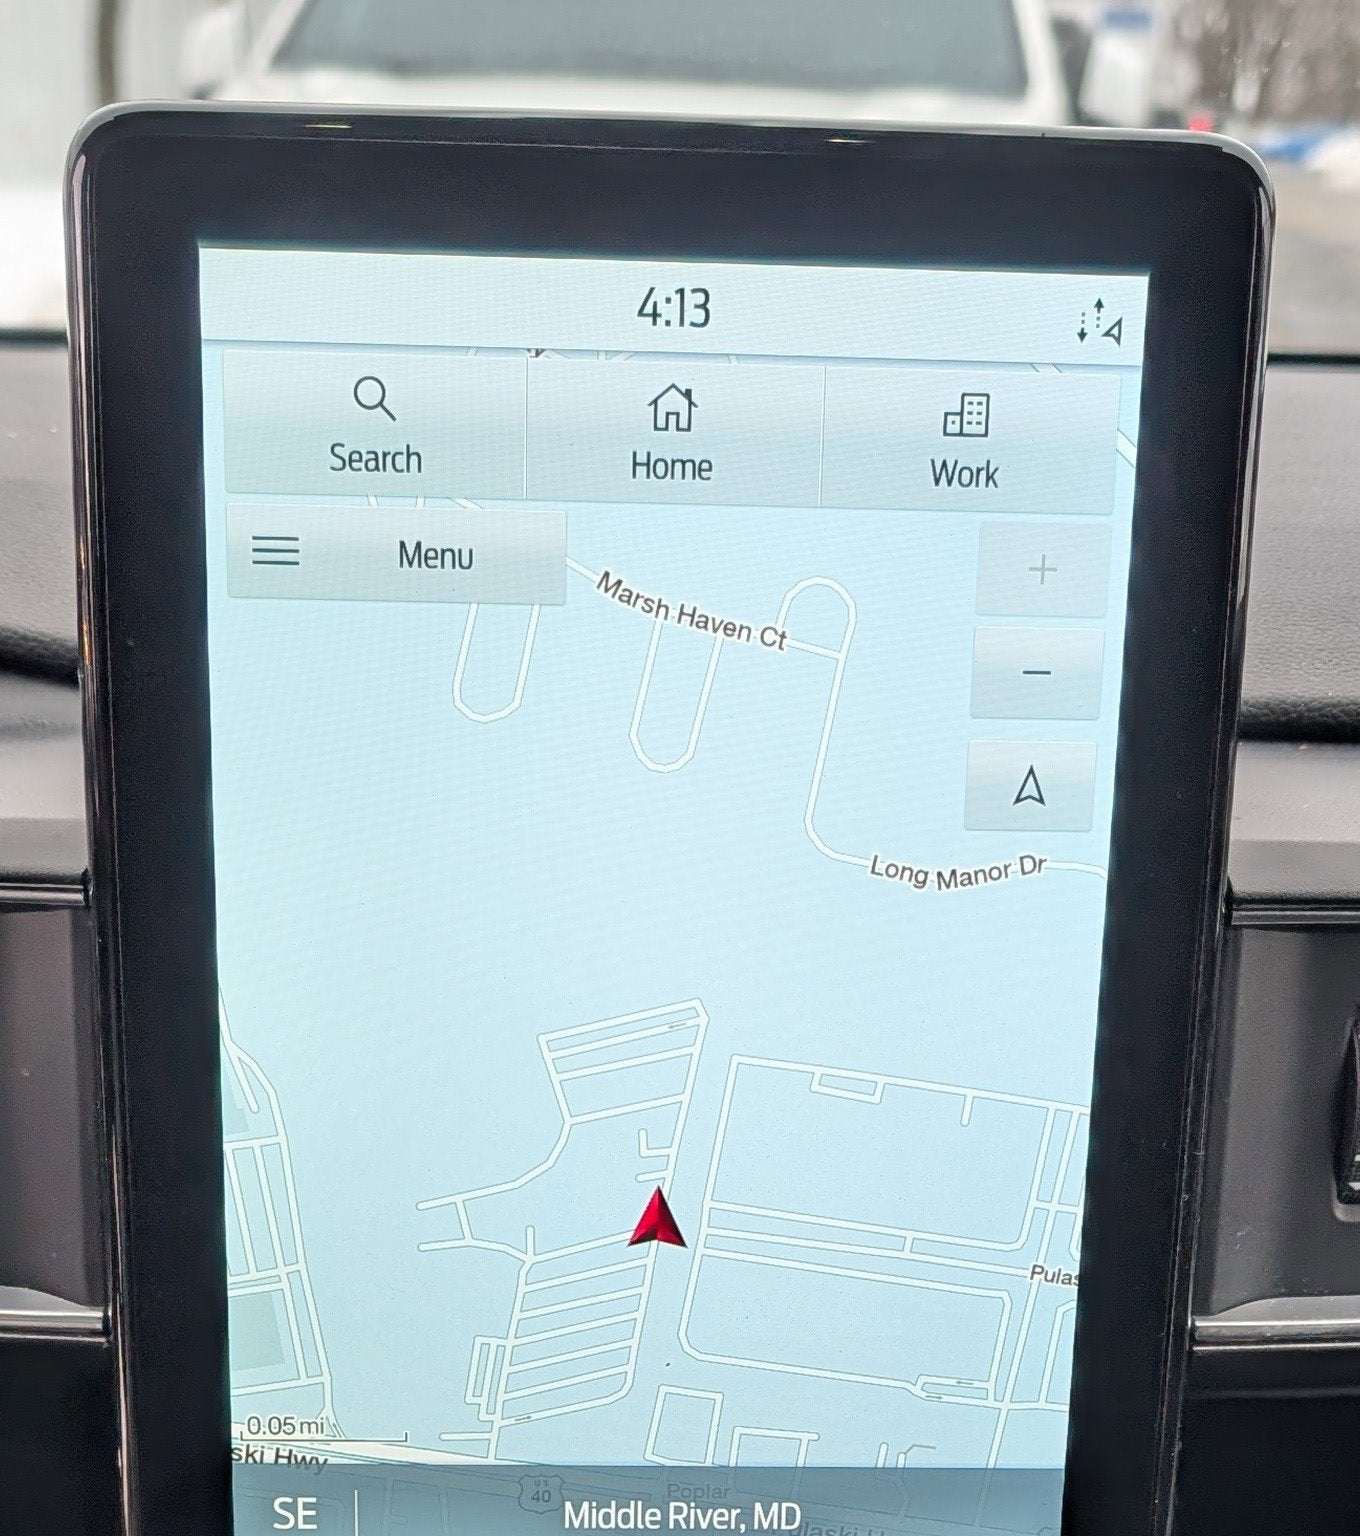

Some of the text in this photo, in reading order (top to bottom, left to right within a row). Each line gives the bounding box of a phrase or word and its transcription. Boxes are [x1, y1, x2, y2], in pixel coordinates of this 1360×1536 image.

[637, 286, 712, 331] 4:13
[329, 442, 423, 476] Search
[631, 452, 714, 483] Home
[929, 460, 1000, 490] Work
[397, 541, 474, 572] Menu
[596, 571, 788, 652] Marsh Haven Ct
[870, 854, 1048, 892] Long Manor Dr
[247, 1416, 325, 1435] 0.05 mi
[274, 1447, 329, 1475] Hwy
[531, 1489, 552, 1503] 40
[273, 1497, 318, 1530] SE
[564, 1500, 802, 1534] Middle River, MD
